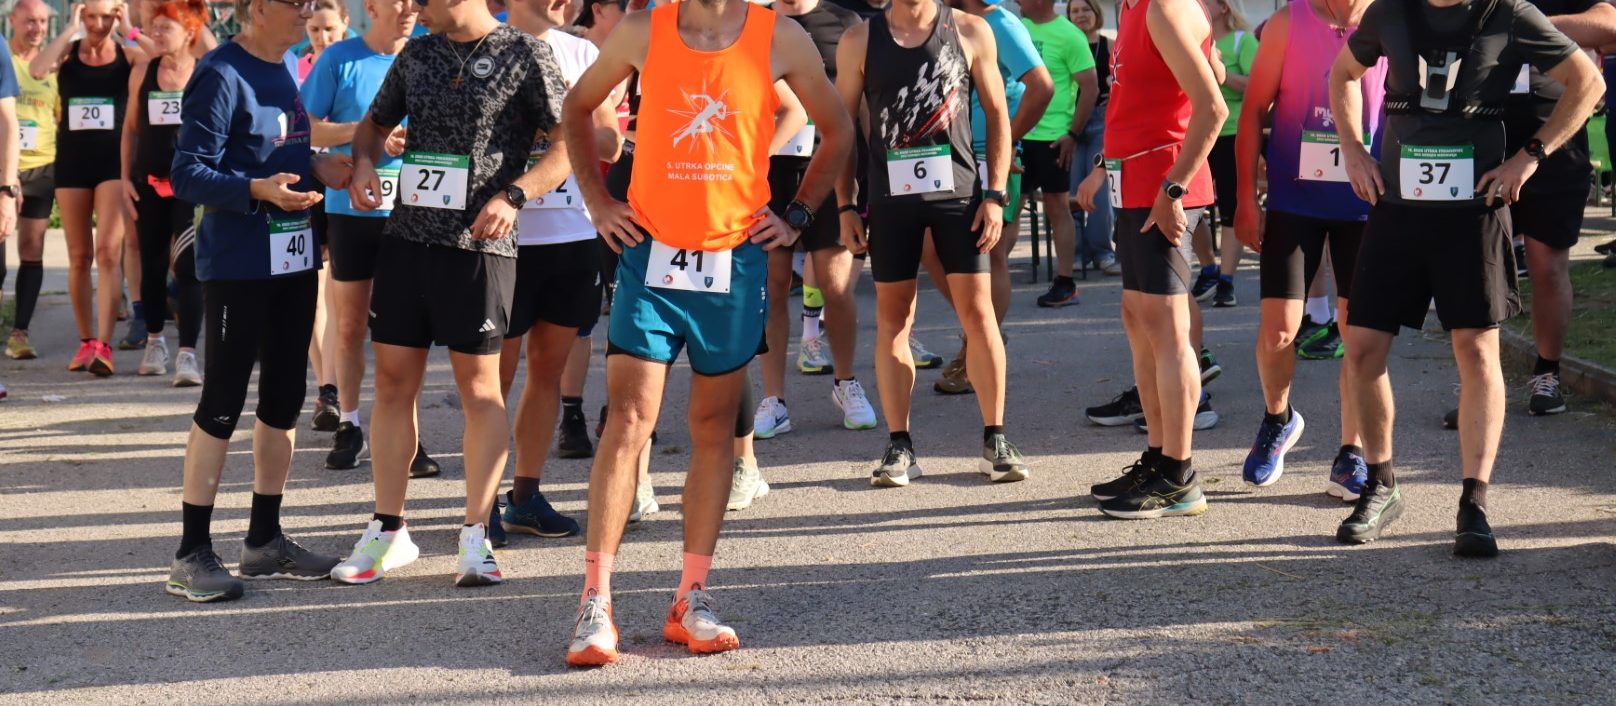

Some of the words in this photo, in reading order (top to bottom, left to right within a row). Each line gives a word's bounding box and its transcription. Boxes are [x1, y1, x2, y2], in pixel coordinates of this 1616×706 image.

[81, 106, 100, 120] 20
[162, 101, 180, 114] 23
[675, 162, 703, 170] UTRKA
[914, 161, 927, 179] 6
[1419, 162, 1451, 185] 37
[416, 168, 446, 191] 27
[286, 233, 305, 256] 40
[670, 249, 704, 272] 41
